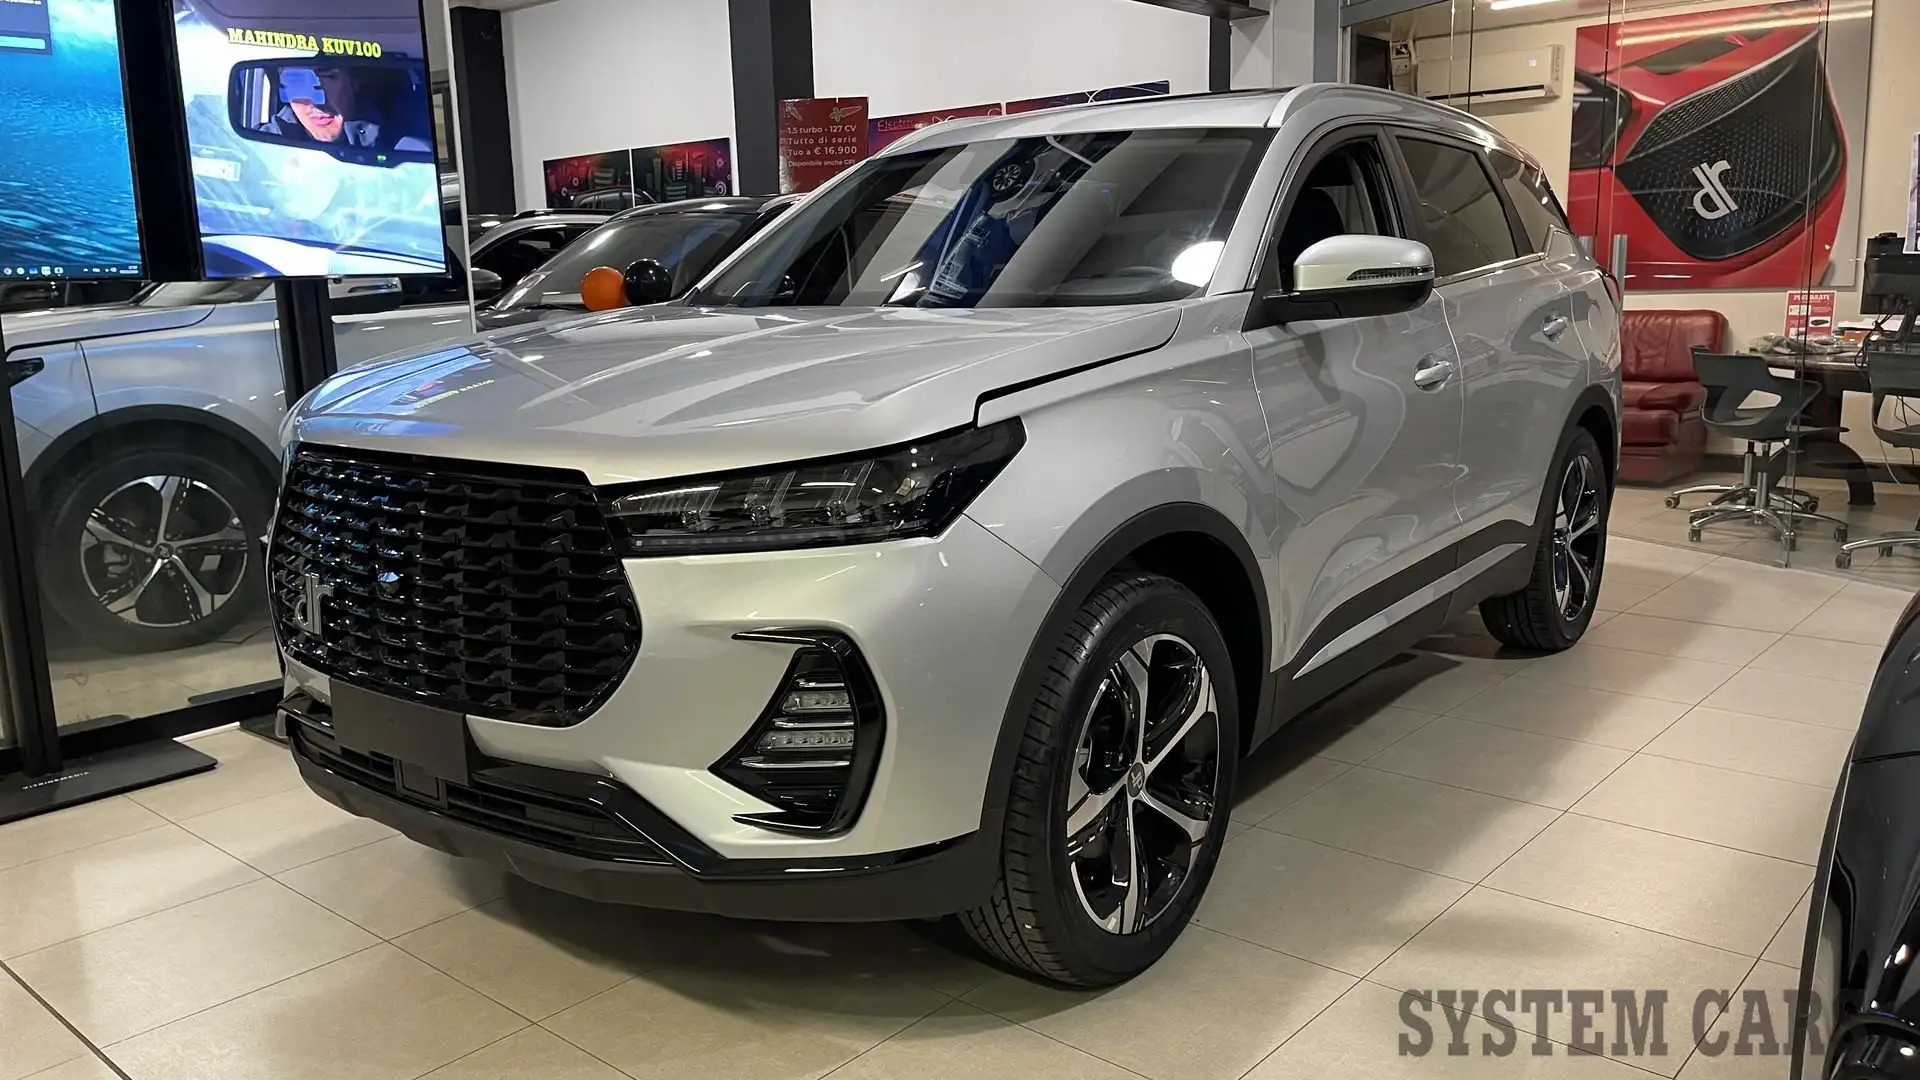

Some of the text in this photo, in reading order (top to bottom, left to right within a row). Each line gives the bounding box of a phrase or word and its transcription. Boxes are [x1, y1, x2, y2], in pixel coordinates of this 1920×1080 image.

[227, 27, 382, 58] MAHINDRA KUV100
[799, 126, 823, 134] turbo
[788, 137, 814, 145] Tutto
[813, 147, 821, 155] €
[824, 146, 857, 155] 16.900
